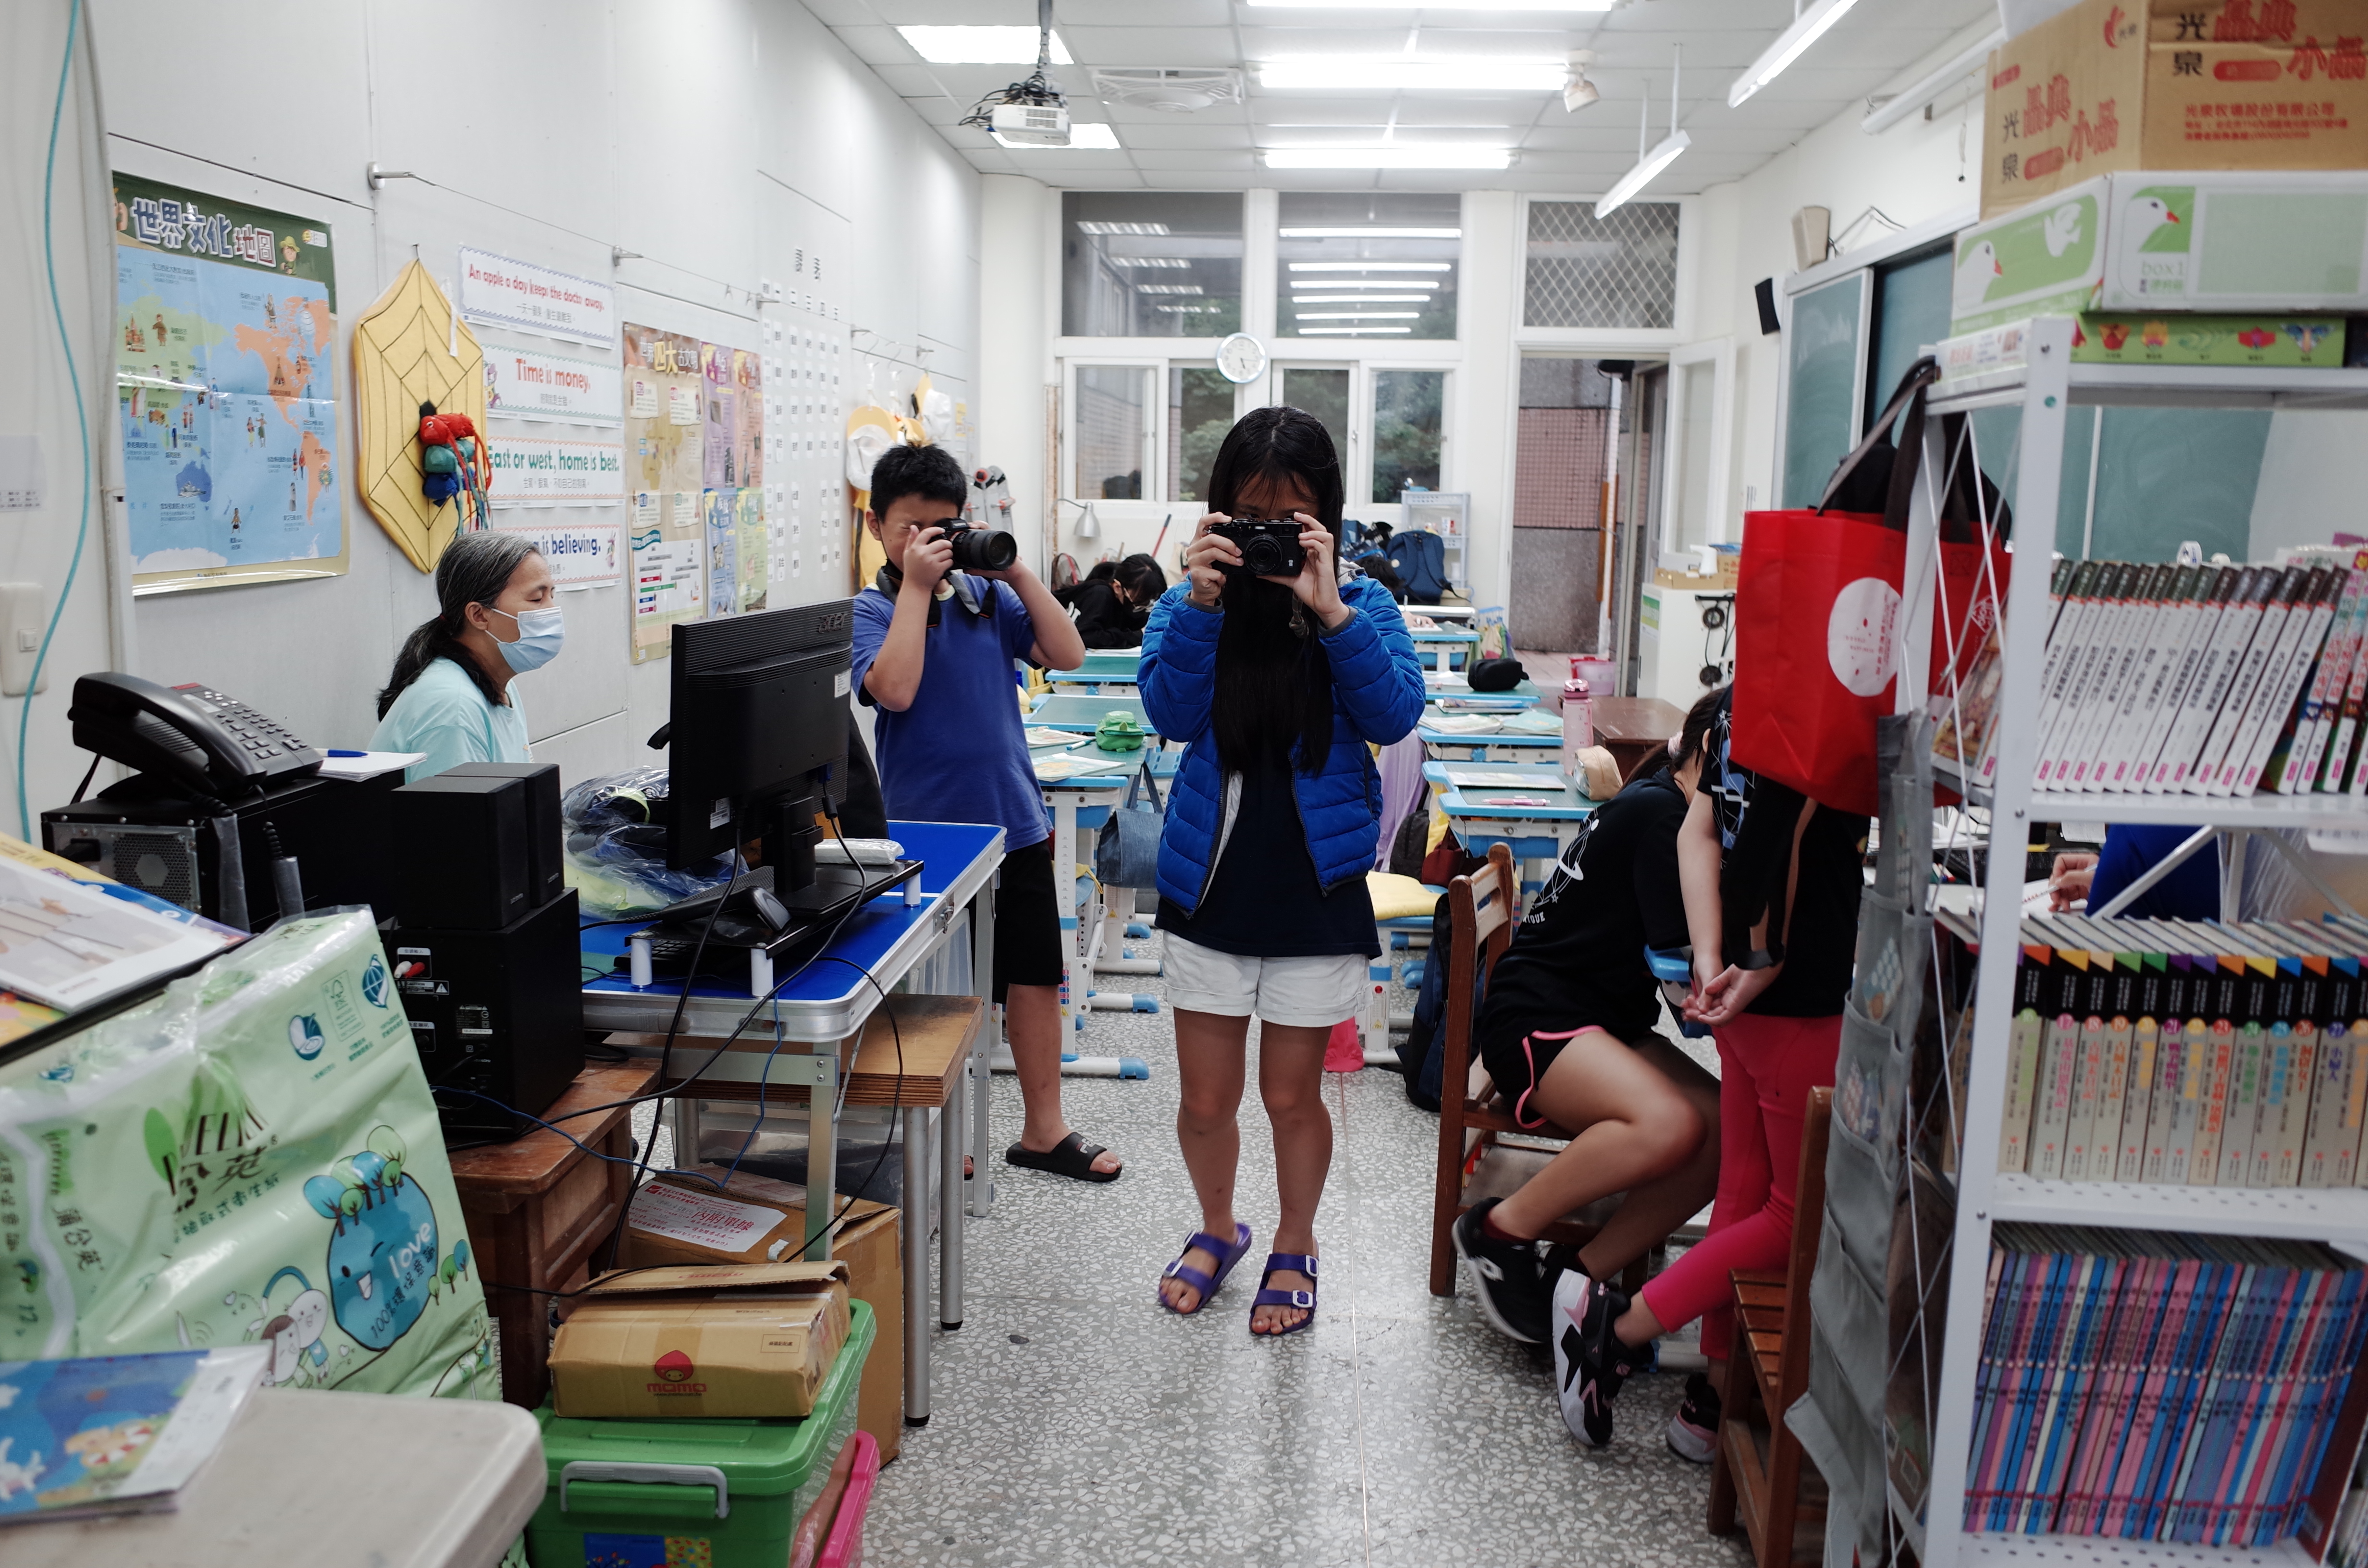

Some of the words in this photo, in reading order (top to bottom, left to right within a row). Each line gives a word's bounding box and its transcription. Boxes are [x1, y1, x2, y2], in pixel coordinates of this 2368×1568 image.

[2172, 13, 2207, 76] 光泉
[2002, 110, 2019, 184] 光泉
[129, 196, 277, 268] 世界文化地圖
[469, 264, 481, 280] An
[483, 271, 504, 287] apple
[506, 278, 510, 288] a
[513, 276, 528, 294] day
[550, 285, 562, 300] the
[585, 298, 604, 312] away.
[516, 358, 544, 383] Time
[546, 363, 552, 384] is
[555, 371, 591, 393] money.
[514, 453, 525, 469] or
[528, 450, 556, 474] west,
[559, 449, 589, 471] home
[590, 452, 597, 471] is
[600, 451, 619, 472] best.
[542, 535, 549, 556] is
[551, 533, 601, 556] believing.
[817, 612, 848, 634] acer
[2060, 1016, 2072, 1027] 17
[2088, 1019, 2100, 1030] 18
[2113, 1018, 2125, 1029] 19
[2166, 1020, 2178, 1031] 21
[2216, 1021, 2229, 1033] 23
[691, 1211, 755, 1232] 內附單據
[51, 1204, 102, 1272] 蒲公英
[388, 1222, 431, 1278] love
[646, 1383, 707, 1393] momo
